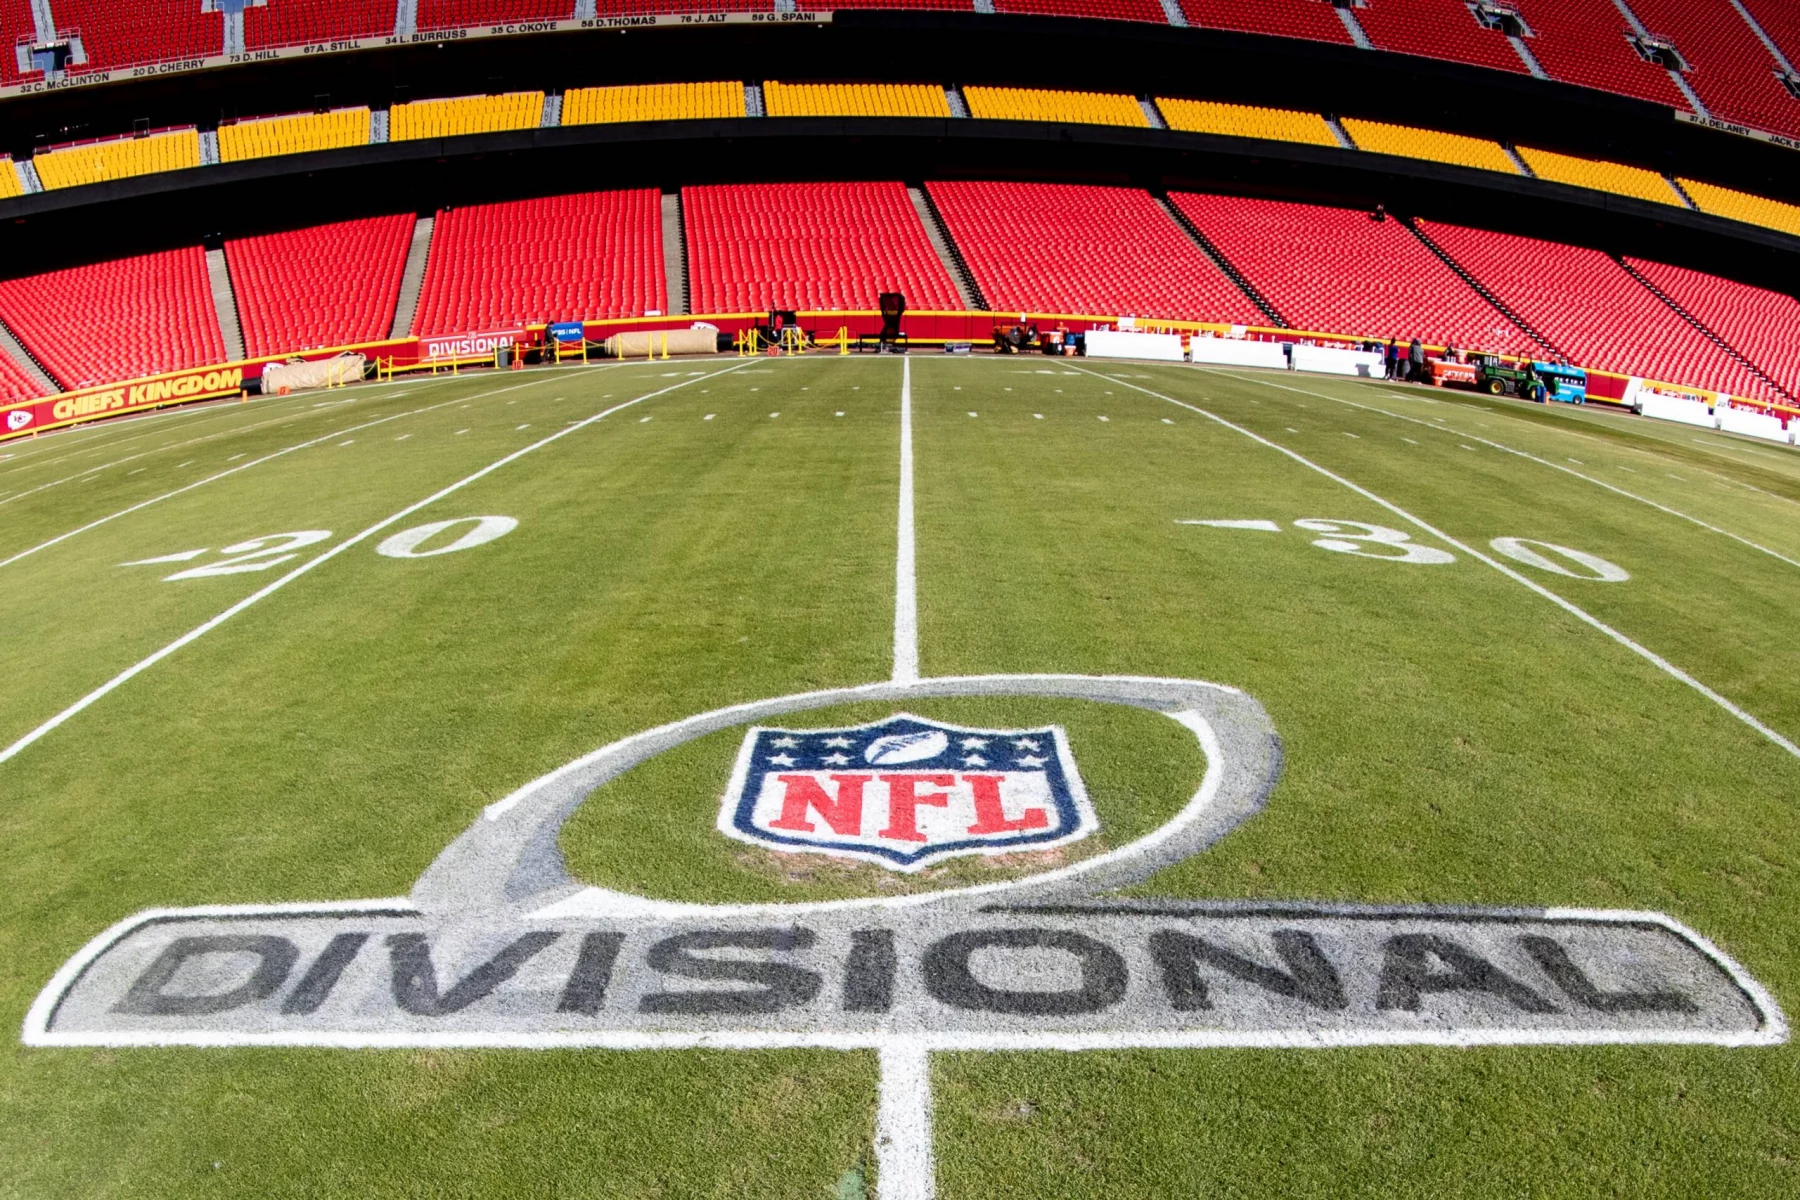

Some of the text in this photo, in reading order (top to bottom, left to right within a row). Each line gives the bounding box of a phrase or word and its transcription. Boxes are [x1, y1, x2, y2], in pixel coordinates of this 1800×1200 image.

[695, 15, 702, 23] J.
[708, 14, 727, 22] ALT
[781, 12, 816, 21] SPANI
[506, 25, 517, 34] C.
[519, 22, 557, 32] OKOYE
[385, 30, 467, 45] 34 L. BURRUSS
[330, 41, 360, 51] STILL
[230, 50, 280, 63] 73 D. HILL
[133, 59, 205, 76] 20 D. CHERRY
[20, 73, 109, 93] 32 C. McCLINTON
[1700, 118, 1708, 126] J.
[1709, 120, 1750, 136] DELANEY
[1768, 135, 1792, 147] JACK
[53, 368, 242, 419] CHIEFS KINGDOM
[768, 774, 1049, 842] NFL
[108, 926, 1702, 1016] DIVISIONAL
